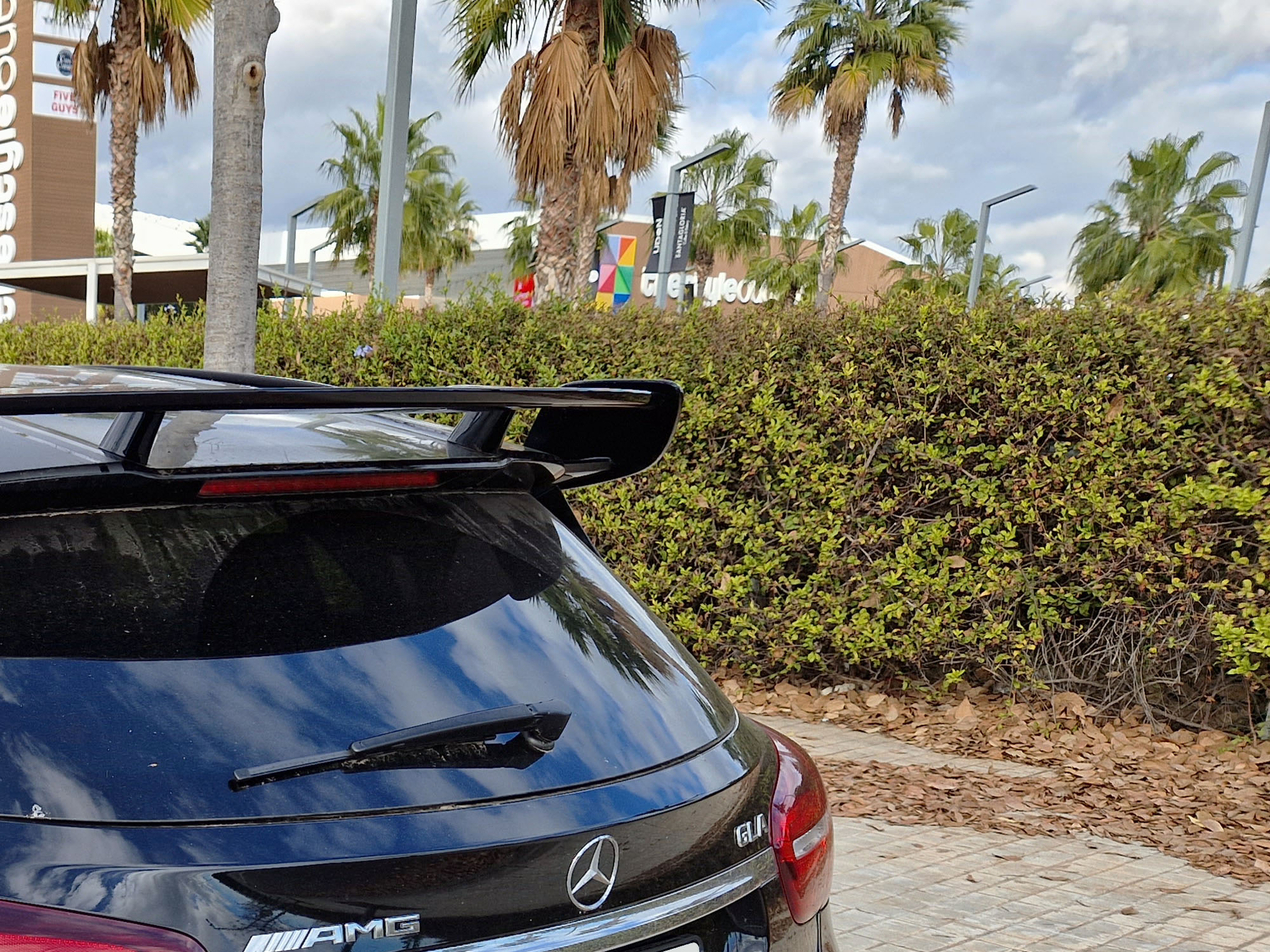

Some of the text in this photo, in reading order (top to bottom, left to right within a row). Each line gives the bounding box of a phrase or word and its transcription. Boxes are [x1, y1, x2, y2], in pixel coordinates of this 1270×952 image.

[652, 218, 663, 255] UDON
[734, 813, 768, 848] GLA
[301, 913, 421, 949] AMG
